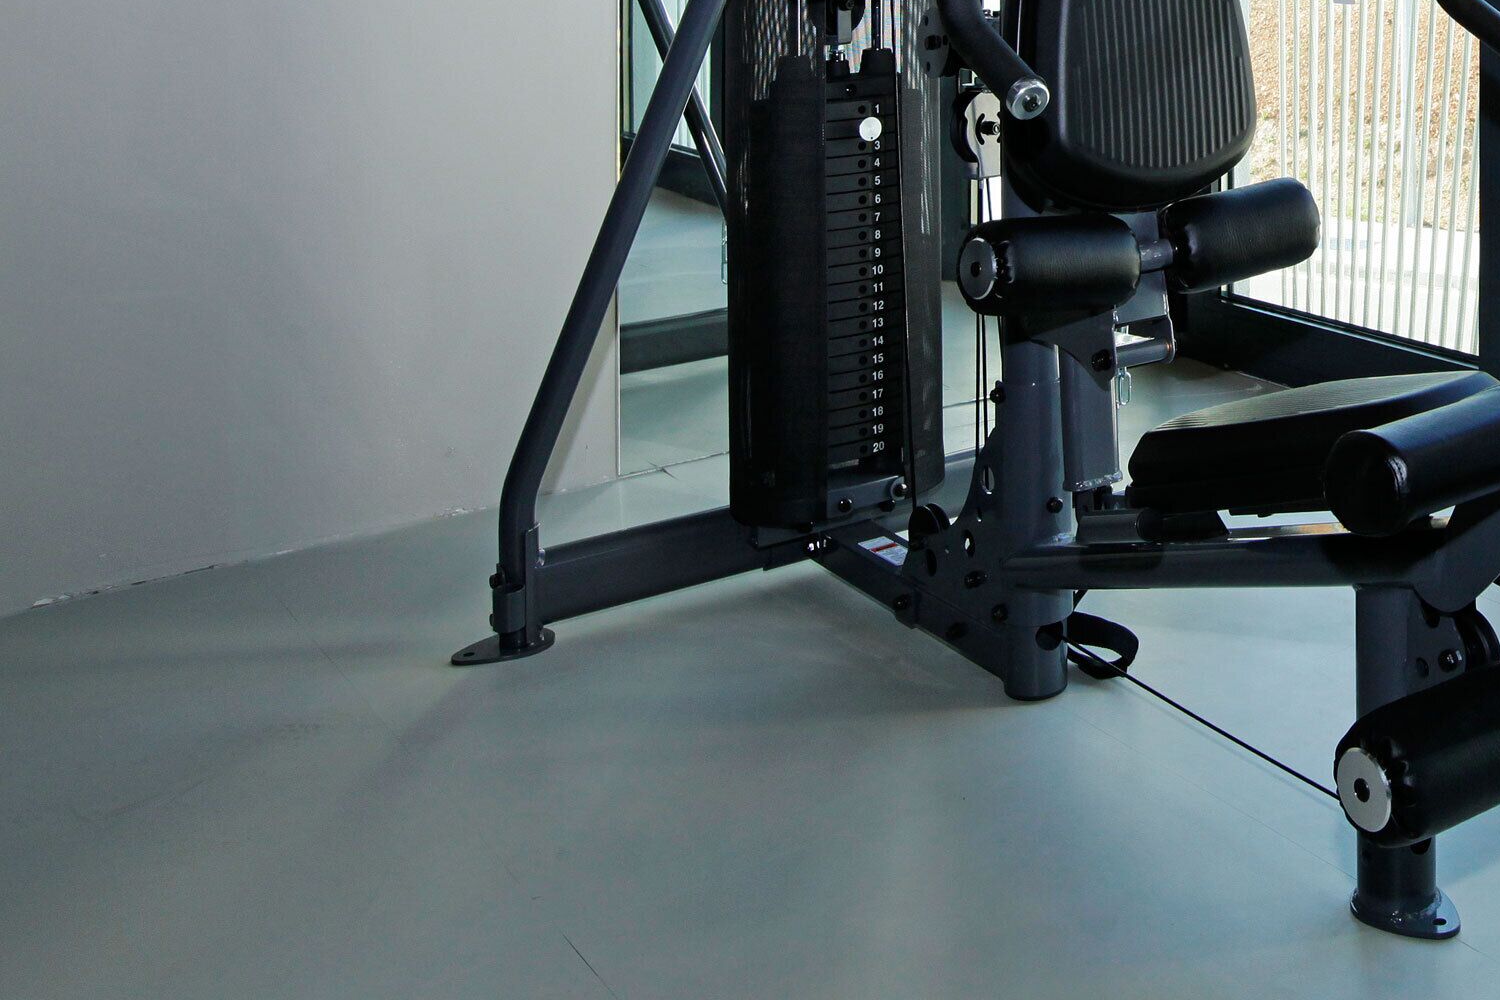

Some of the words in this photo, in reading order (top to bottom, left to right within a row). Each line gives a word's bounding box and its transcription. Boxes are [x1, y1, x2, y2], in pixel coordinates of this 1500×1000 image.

[874, 103, 881, 114] 1
[874, 139, 881, 151] 3
[874, 157, 881, 168] 4
[874, 175, 881, 186] 5
[874, 193, 881, 204] 6
[874, 211, 881, 222] 7
[874, 229, 881, 240] 8
[874, 247, 881, 258] 9
[872, 264, 884, 276] 10
[872, 281, 884, 293] 11
[872, 299, 884, 311] 12
[872, 317, 884, 328] 13
[872, 335, 884, 347] 14
[872, 352, 884, 364] 15
[872, 369, 884, 381] 16
[872, 388, 884, 400] 17
[872, 405, 884, 417] 18
[872, 423, 884, 435] 19
[872, 441, 884, 453] 20
